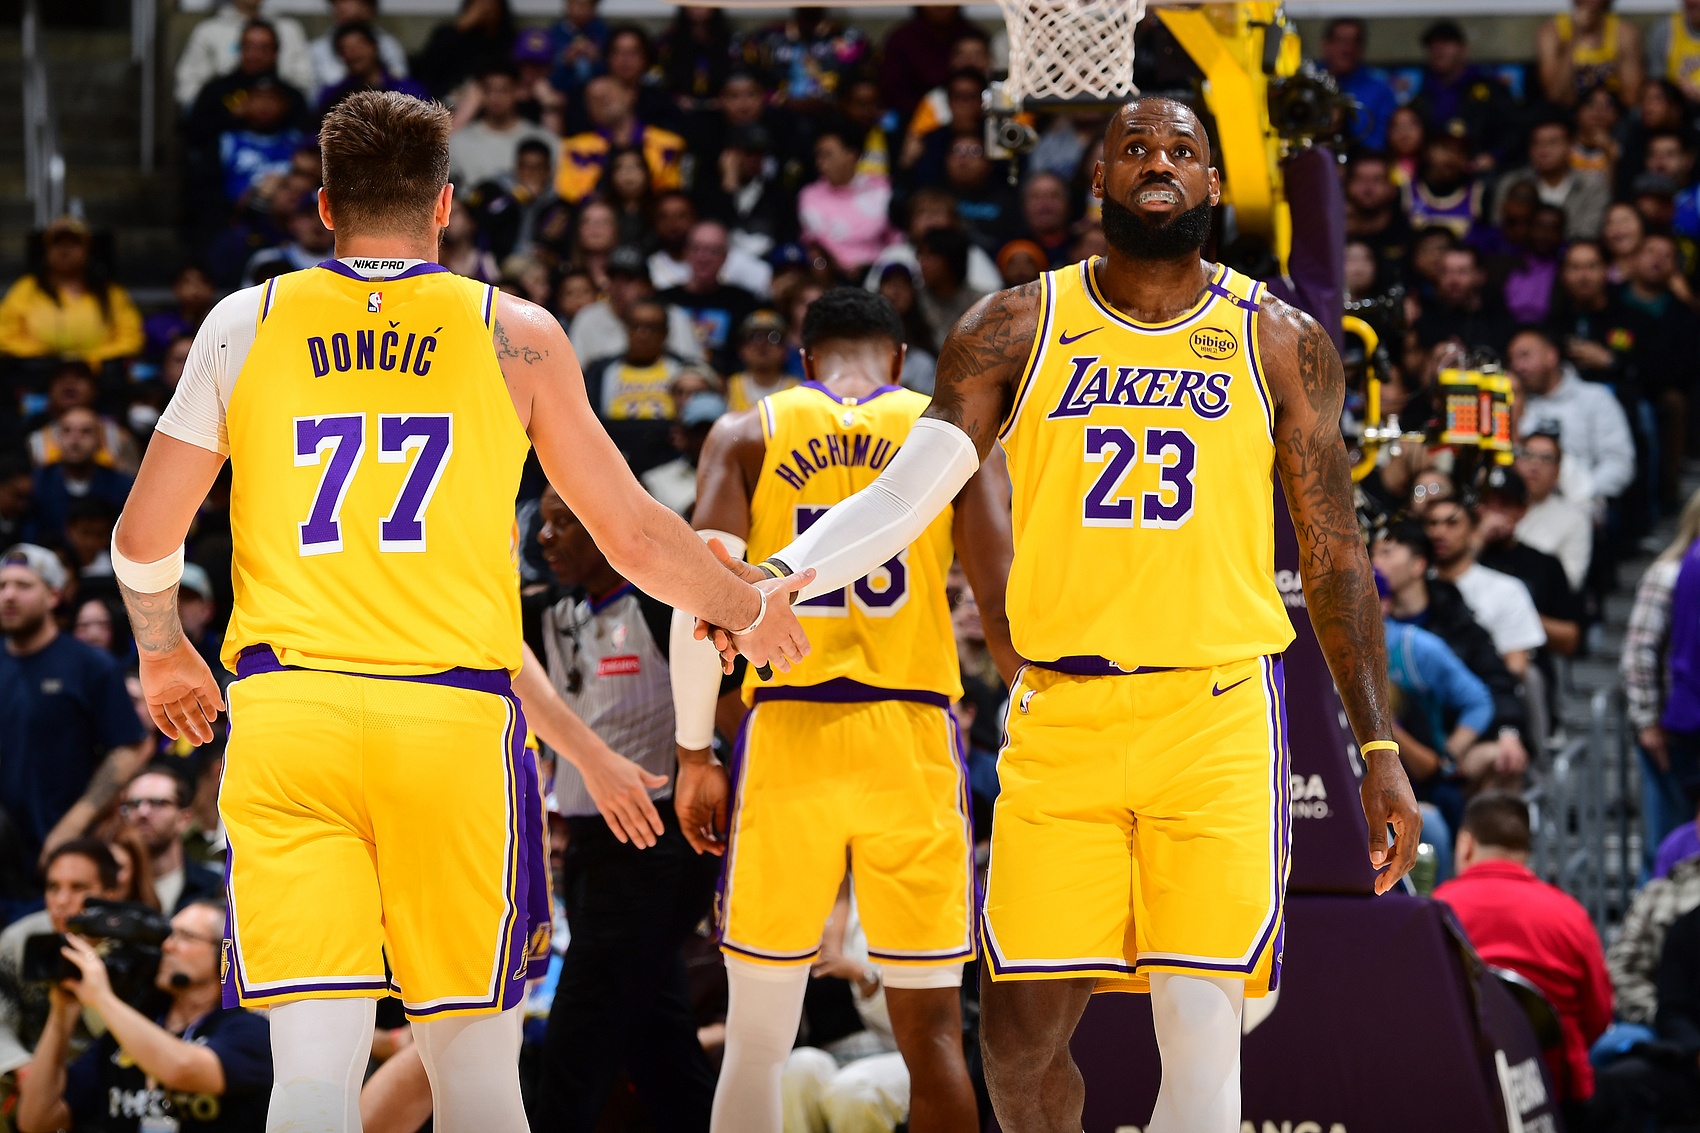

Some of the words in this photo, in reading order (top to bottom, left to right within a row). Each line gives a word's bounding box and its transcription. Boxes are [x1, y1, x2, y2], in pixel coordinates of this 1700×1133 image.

[352, 259, 379, 270] NIKE
[380, 260, 405, 270] PRO
[307, 320, 443, 378] DONČIĆ
[1194, 334, 1235, 352] bibigo
[1047, 355, 1233, 421] LAKERS
[293, 411, 454, 557] 77
[775, 433, 901, 491] HACHIMU
[1082, 425, 1198, 530] 23
